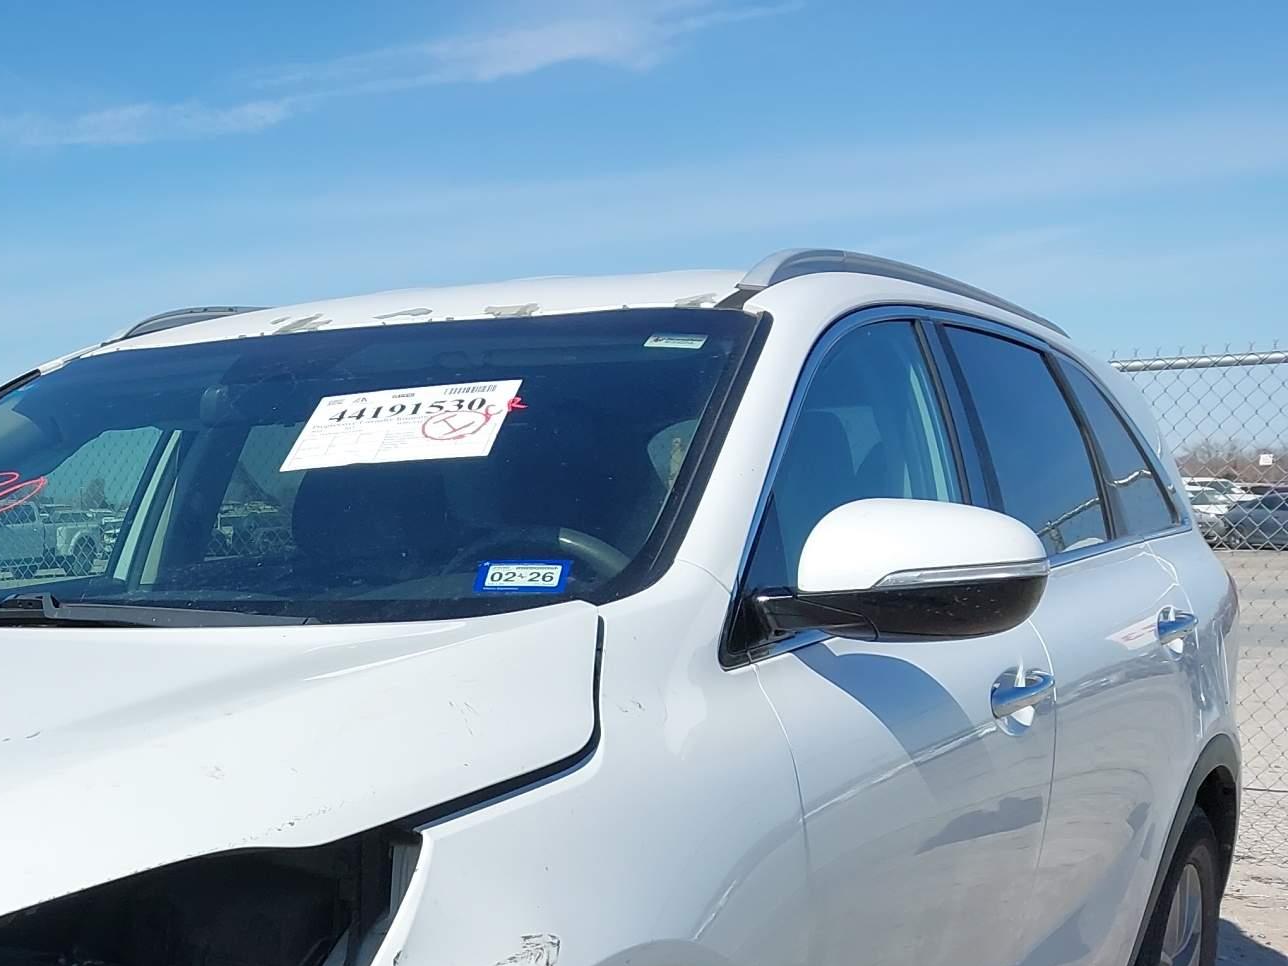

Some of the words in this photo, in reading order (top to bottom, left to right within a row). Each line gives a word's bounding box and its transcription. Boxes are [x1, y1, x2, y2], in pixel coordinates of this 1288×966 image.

[329, 397, 487, 423] 44191530
[490, 571, 517, 583] 02
[527, 571, 555, 583] 26
